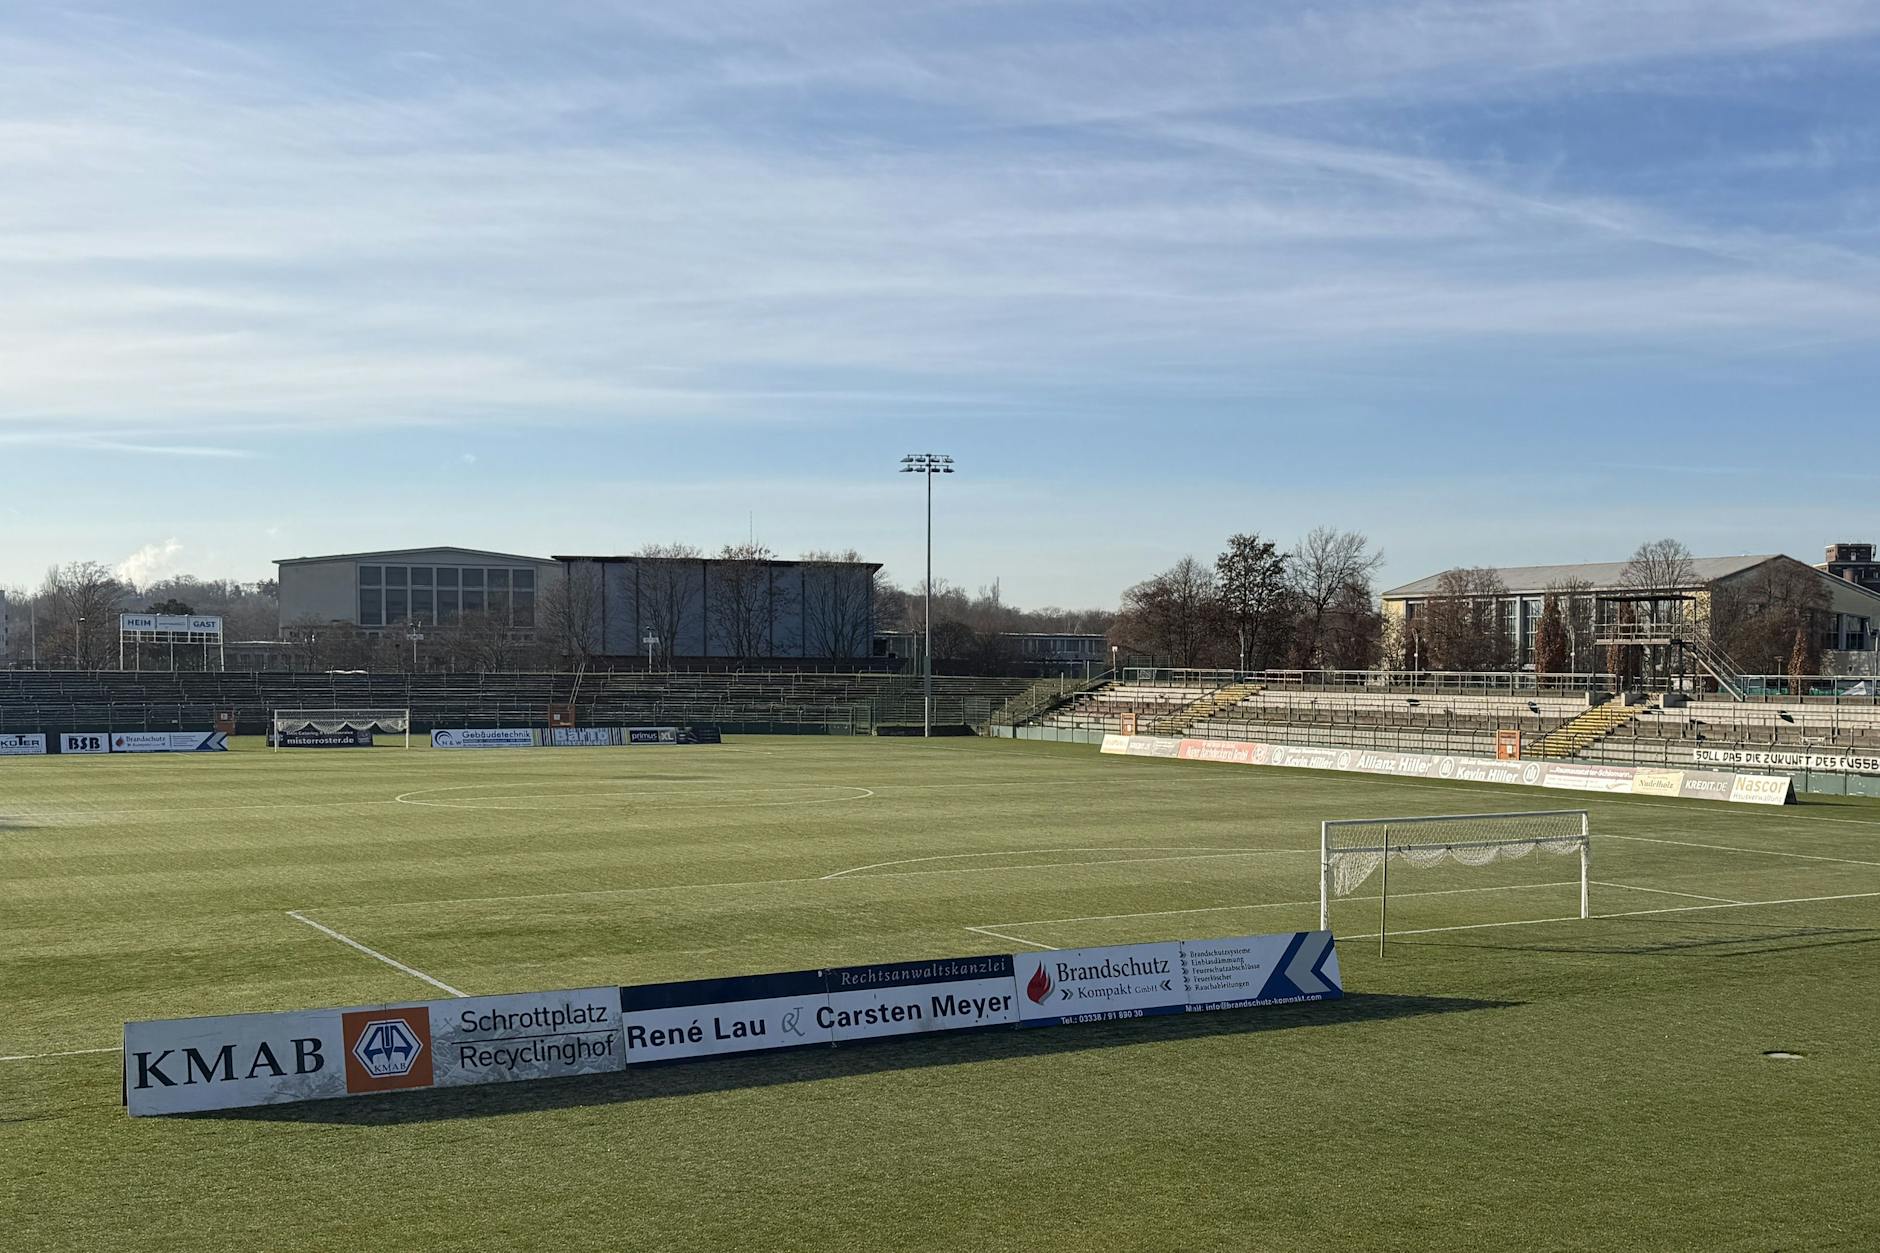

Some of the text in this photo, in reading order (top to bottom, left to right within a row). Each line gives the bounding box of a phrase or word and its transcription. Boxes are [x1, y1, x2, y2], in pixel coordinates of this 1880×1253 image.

[128, 619, 151, 627] HEIM
[193, 620, 216, 628] GAST
[287, 736, 355, 744] misterroster.de
[462, 730, 530, 738] Gebäudetechnik
[631, 731, 657, 741] primus
[660, 731, 674, 740] XL
[68, 737, 100, 750] BSB
[1285, 755, 1334, 769] Kevin Hiller
[1356, 755, 1433, 773] Allianz Hiller
[1696, 751, 1719, 761] SOLL
[1722, 752, 1742, 762] DAS
[1745, 753, 1761, 763] DIE
[1764, 754, 1811, 766] ZUKUNFT
[1815, 755, 1836, 767] DES
[1456, 767, 1519, 783] Kevin Hiller
[1685, 779, 1728, 792] KREDIT.DE
[1735, 776, 1786, 793] Nascor
[1190, 948, 1251, 958] Brandschutzsysteme
[841, 958, 1006, 986] Rechtsanwaltskanzlei
[1056, 957, 1170, 982] Brandschutz
[1192, 963, 1260, 974] Feuerschutzabschlüsse
[1193, 974, 1232, 982] Feuerlöscher
[1078, 983, 1158, 1000] Kompakt GmbH
[1185, 1004, 1205, 1013] Mail:
[460, 1003, 608, 1034] Schrottplatz
[627, 1019, 703, 1049] René
[714, 1017, 766, 1041] Lau
[816, 1003, 922, 1029] Carsten
[931, 994, 1012, 1019] Meyer
[1060, 1016, 1078, 1025] Tel.:
[1079, 1013, 1102, 1023] 03338
[1107, 1012, 1117, 1020] 91
[1134, 1009, 1144, 1018] 30
[459, 1034, 614, 1071] Recyclinghof
[132, 1037, 325, 1090] KMAB
[373, 1062, 407, 1073] KMAB
